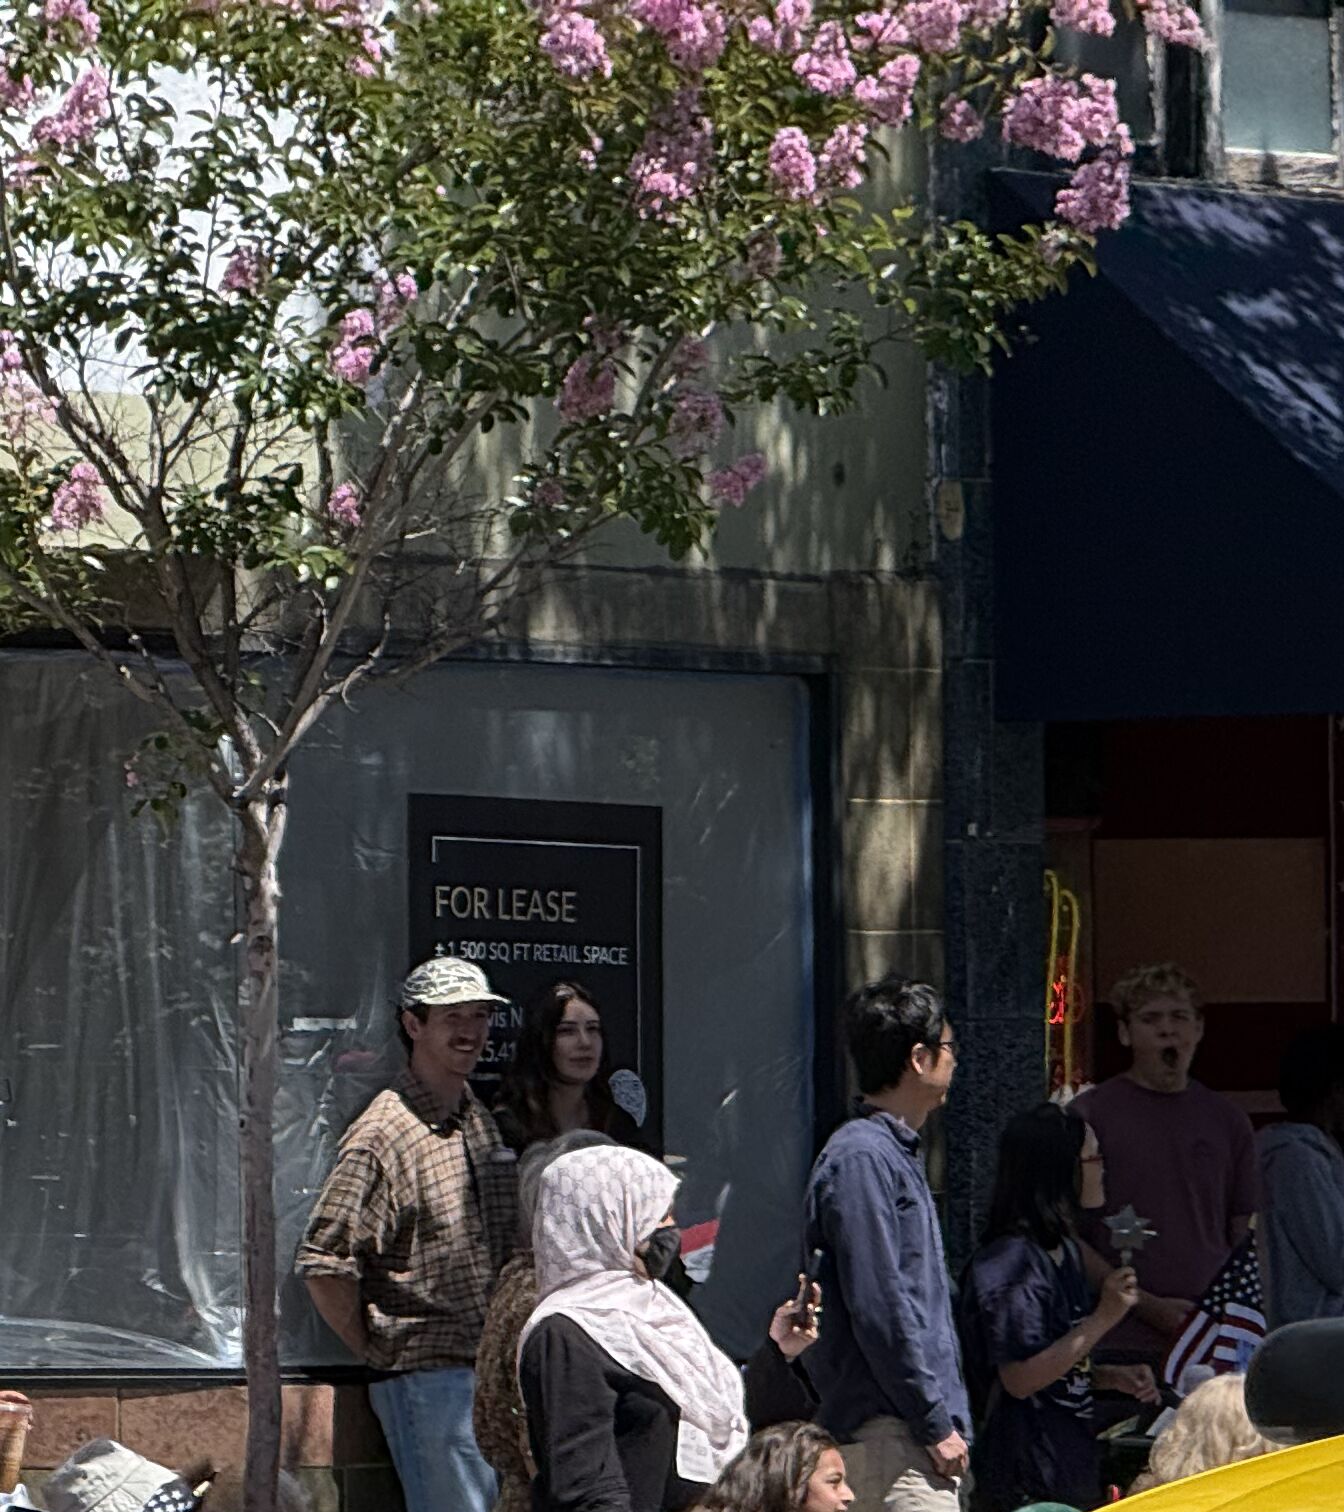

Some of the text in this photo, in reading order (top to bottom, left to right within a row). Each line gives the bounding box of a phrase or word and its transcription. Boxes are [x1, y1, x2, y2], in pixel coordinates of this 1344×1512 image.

[434, 886, 577, 923] FOR LEASE
[489, 943, 510, 963] SQ
[513, 943, 530, 961] FT
[533, 944, 583, 963] RETAIL
[583, 946, 629, 965] SPACE
